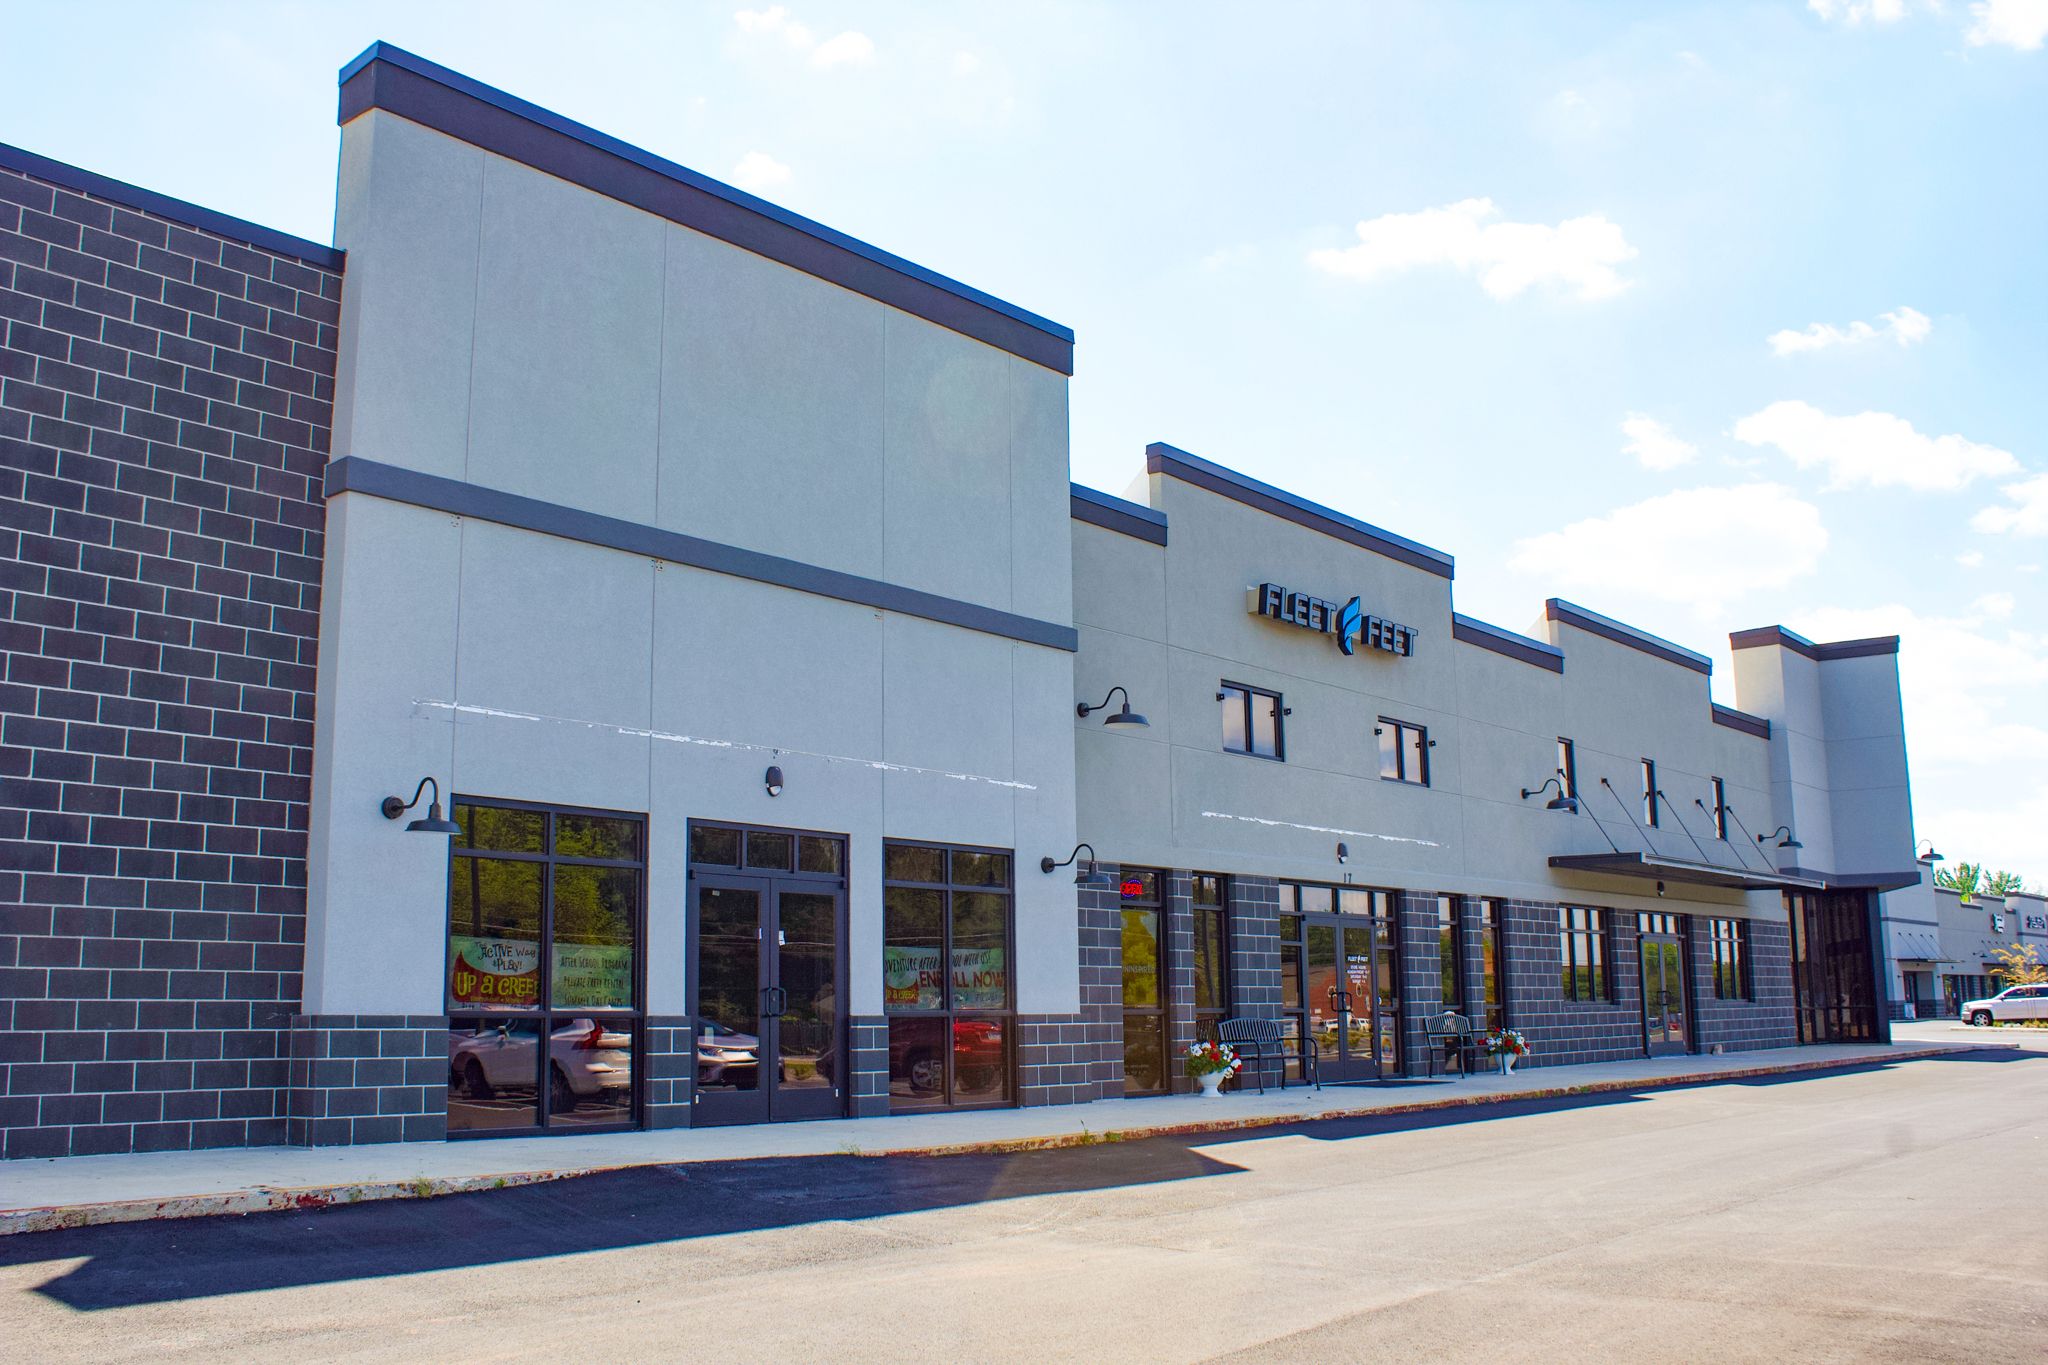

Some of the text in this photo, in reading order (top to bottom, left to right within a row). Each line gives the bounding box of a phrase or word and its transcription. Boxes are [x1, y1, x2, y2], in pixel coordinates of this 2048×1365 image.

[1259, 583, 1419, 657] FLEET FEET
[1344, 872, 1352, 884] 17
[1120, 881, 1143, 895] OPEN
[478, 943, 513, 960] ACTIVE
[560, 956, 577, 969] AFTER
[919, 956, 937, 970] AFTER
[457, 972, 477, 996] UP
[973, 971, 1004, 988] NOW
